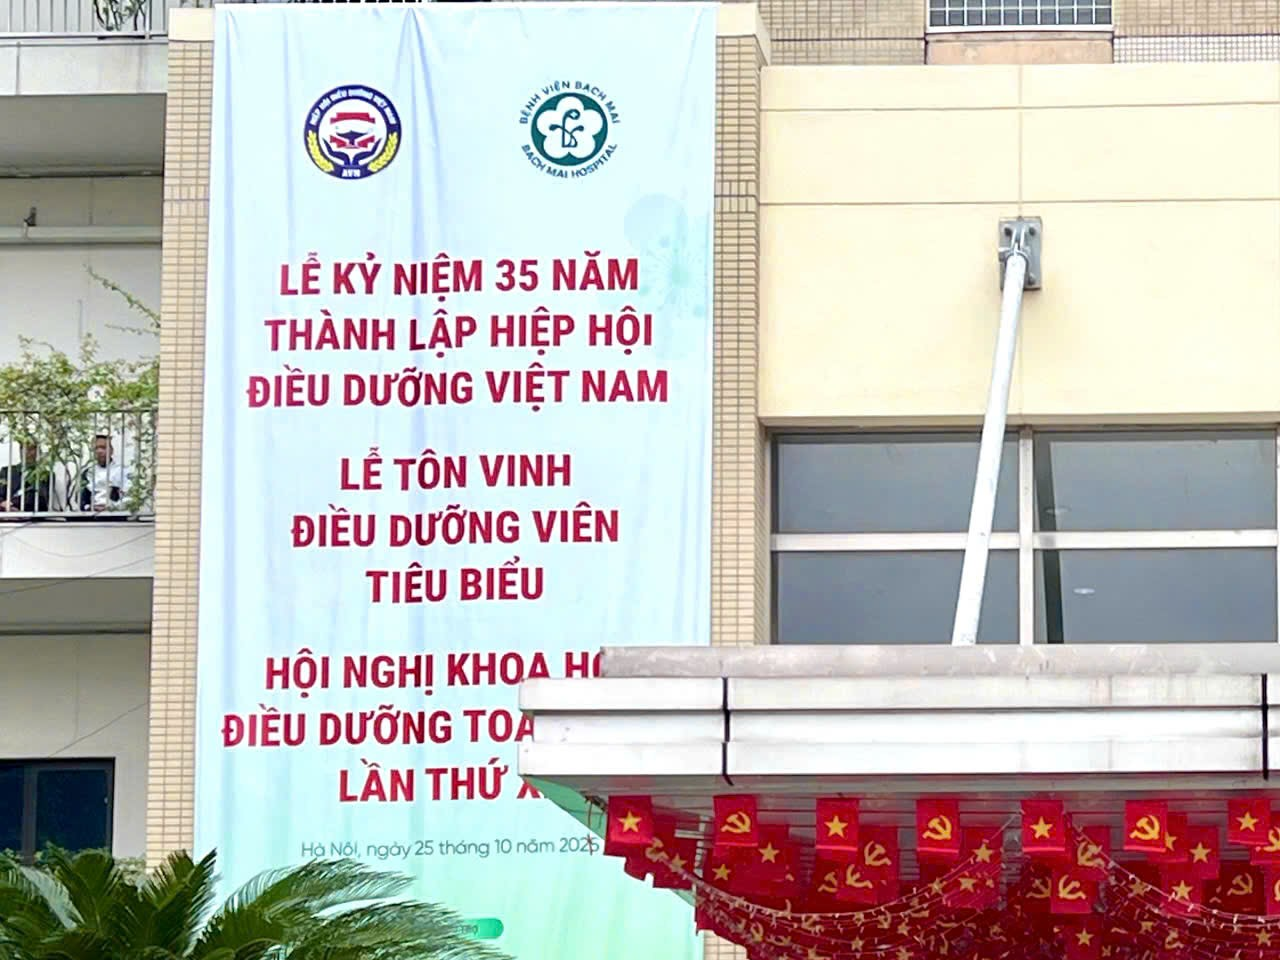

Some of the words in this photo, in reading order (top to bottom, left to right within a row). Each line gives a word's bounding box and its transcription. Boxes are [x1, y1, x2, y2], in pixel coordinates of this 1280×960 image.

[279, 252, 321, 296] LỄ
[333, 252, 381, 295] KỶ
[394, 253, 483, 303] NIỆM
[495, 259, 540, 293] 35
[552, 251, 639, 291] NĂM
[264, 309, 395, 351] THÀNH
[408, 308, 478, 359] LẬP
[490, 305, 575, 356] HIỆP
[588, 305, 653, 355] HỘI
[246, 364, 330, 408] ĐIỀU
[343, 366, 473, 407] DƯỠNG
[485, 362, 570, 412] VIỆT
[581, 370, 668, 403] NAM
[340, 447, 382, 491] LỄ
[393, 449, 468, 491] TÔN
[479, 454, 571, 488] VINH
[290, 503, 375, 548] ĐIỀU
[389, 505, 520, 547] DƯỠNG
[532, 501, 619, 544] VIÊN
[366, 562, 447, 603] TIÊU
[460, 556, 544, 602] BIỂU
[265, 647, 330, 699] HỘI
[343, 654, 434, 696] NGHỊ
[447, 651, 550, 685] KHOA
[221, 703, 306, 748] ĐIỀU
[318, 704, 451, 746] DƯỠNG
[339, 758, 415, 802] LẦN
[425, 757, 508, 800] THỨ
[301, 841, 325, 857] Hà
[366, 842, 412, 860] ngày
[414, 840, 434, 855] 25
[439, 839, 490, 858] tháng
[495, 838, 512, 854] 10
[517, 838, 555, 853] năm
